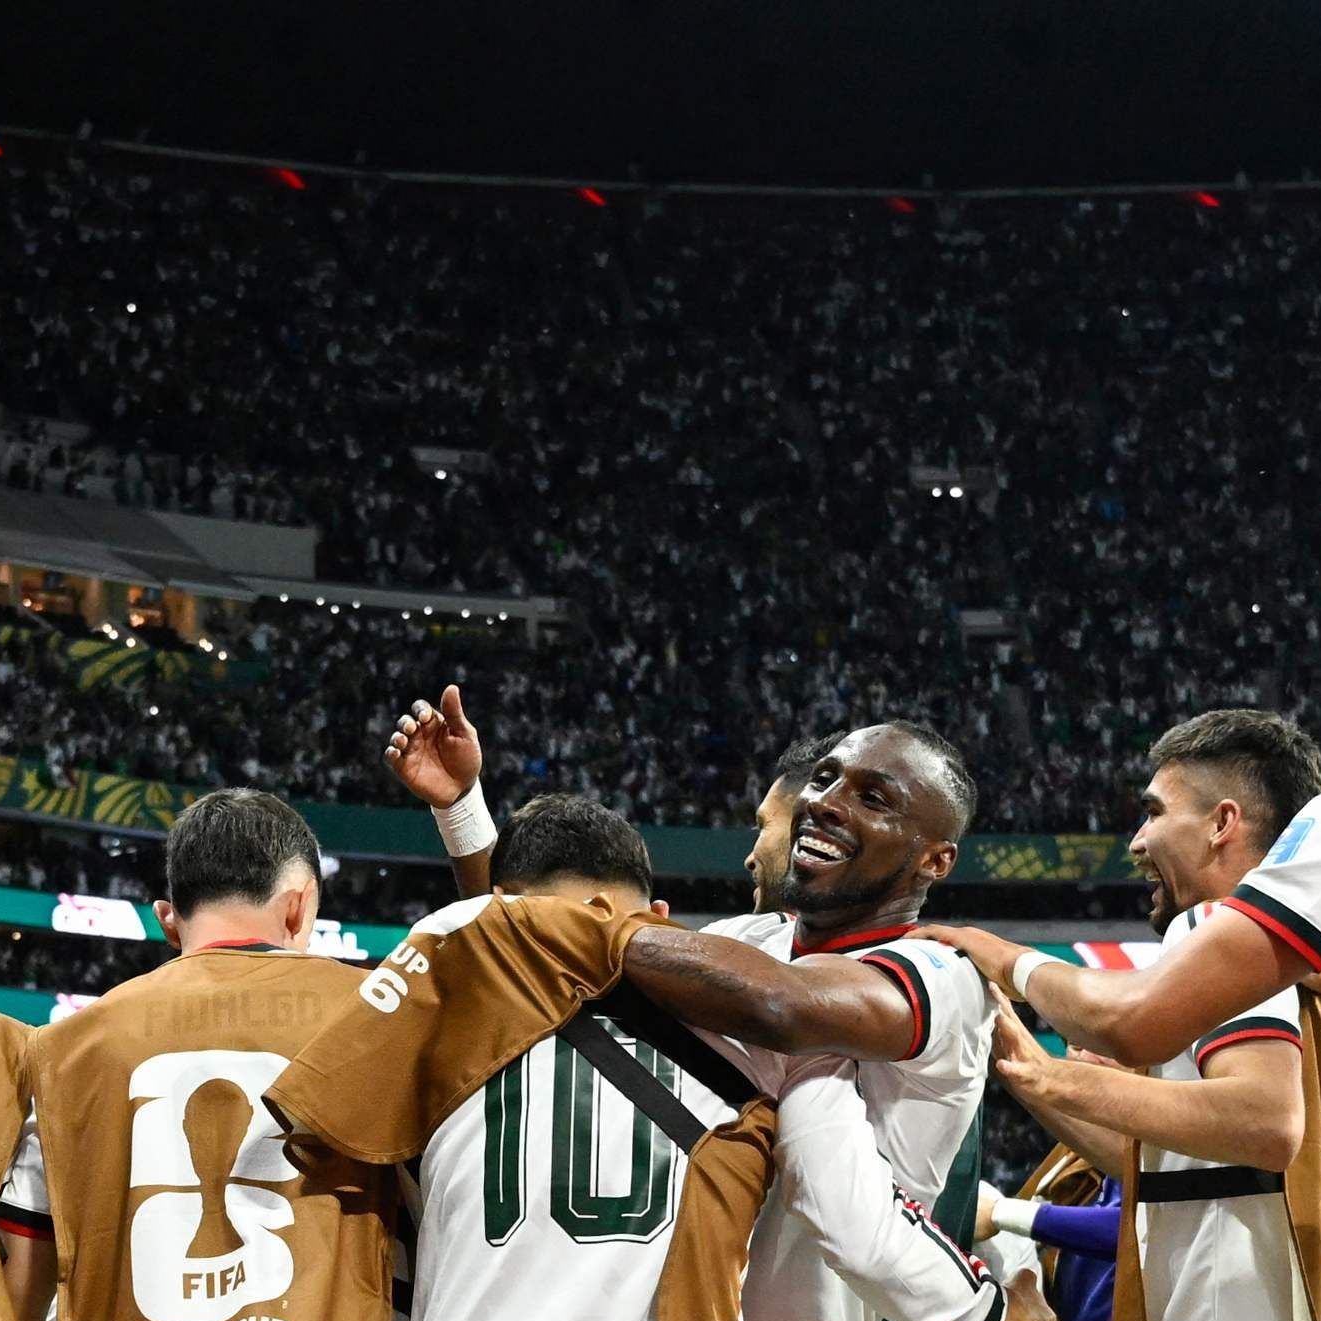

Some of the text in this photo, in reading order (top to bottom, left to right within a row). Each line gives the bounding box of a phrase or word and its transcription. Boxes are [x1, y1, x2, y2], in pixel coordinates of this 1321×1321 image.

[385, 941, 430, 975] UP
[484, 1015, 682, 1247] 10
[182, 1260, 247, 1300] FIFA
